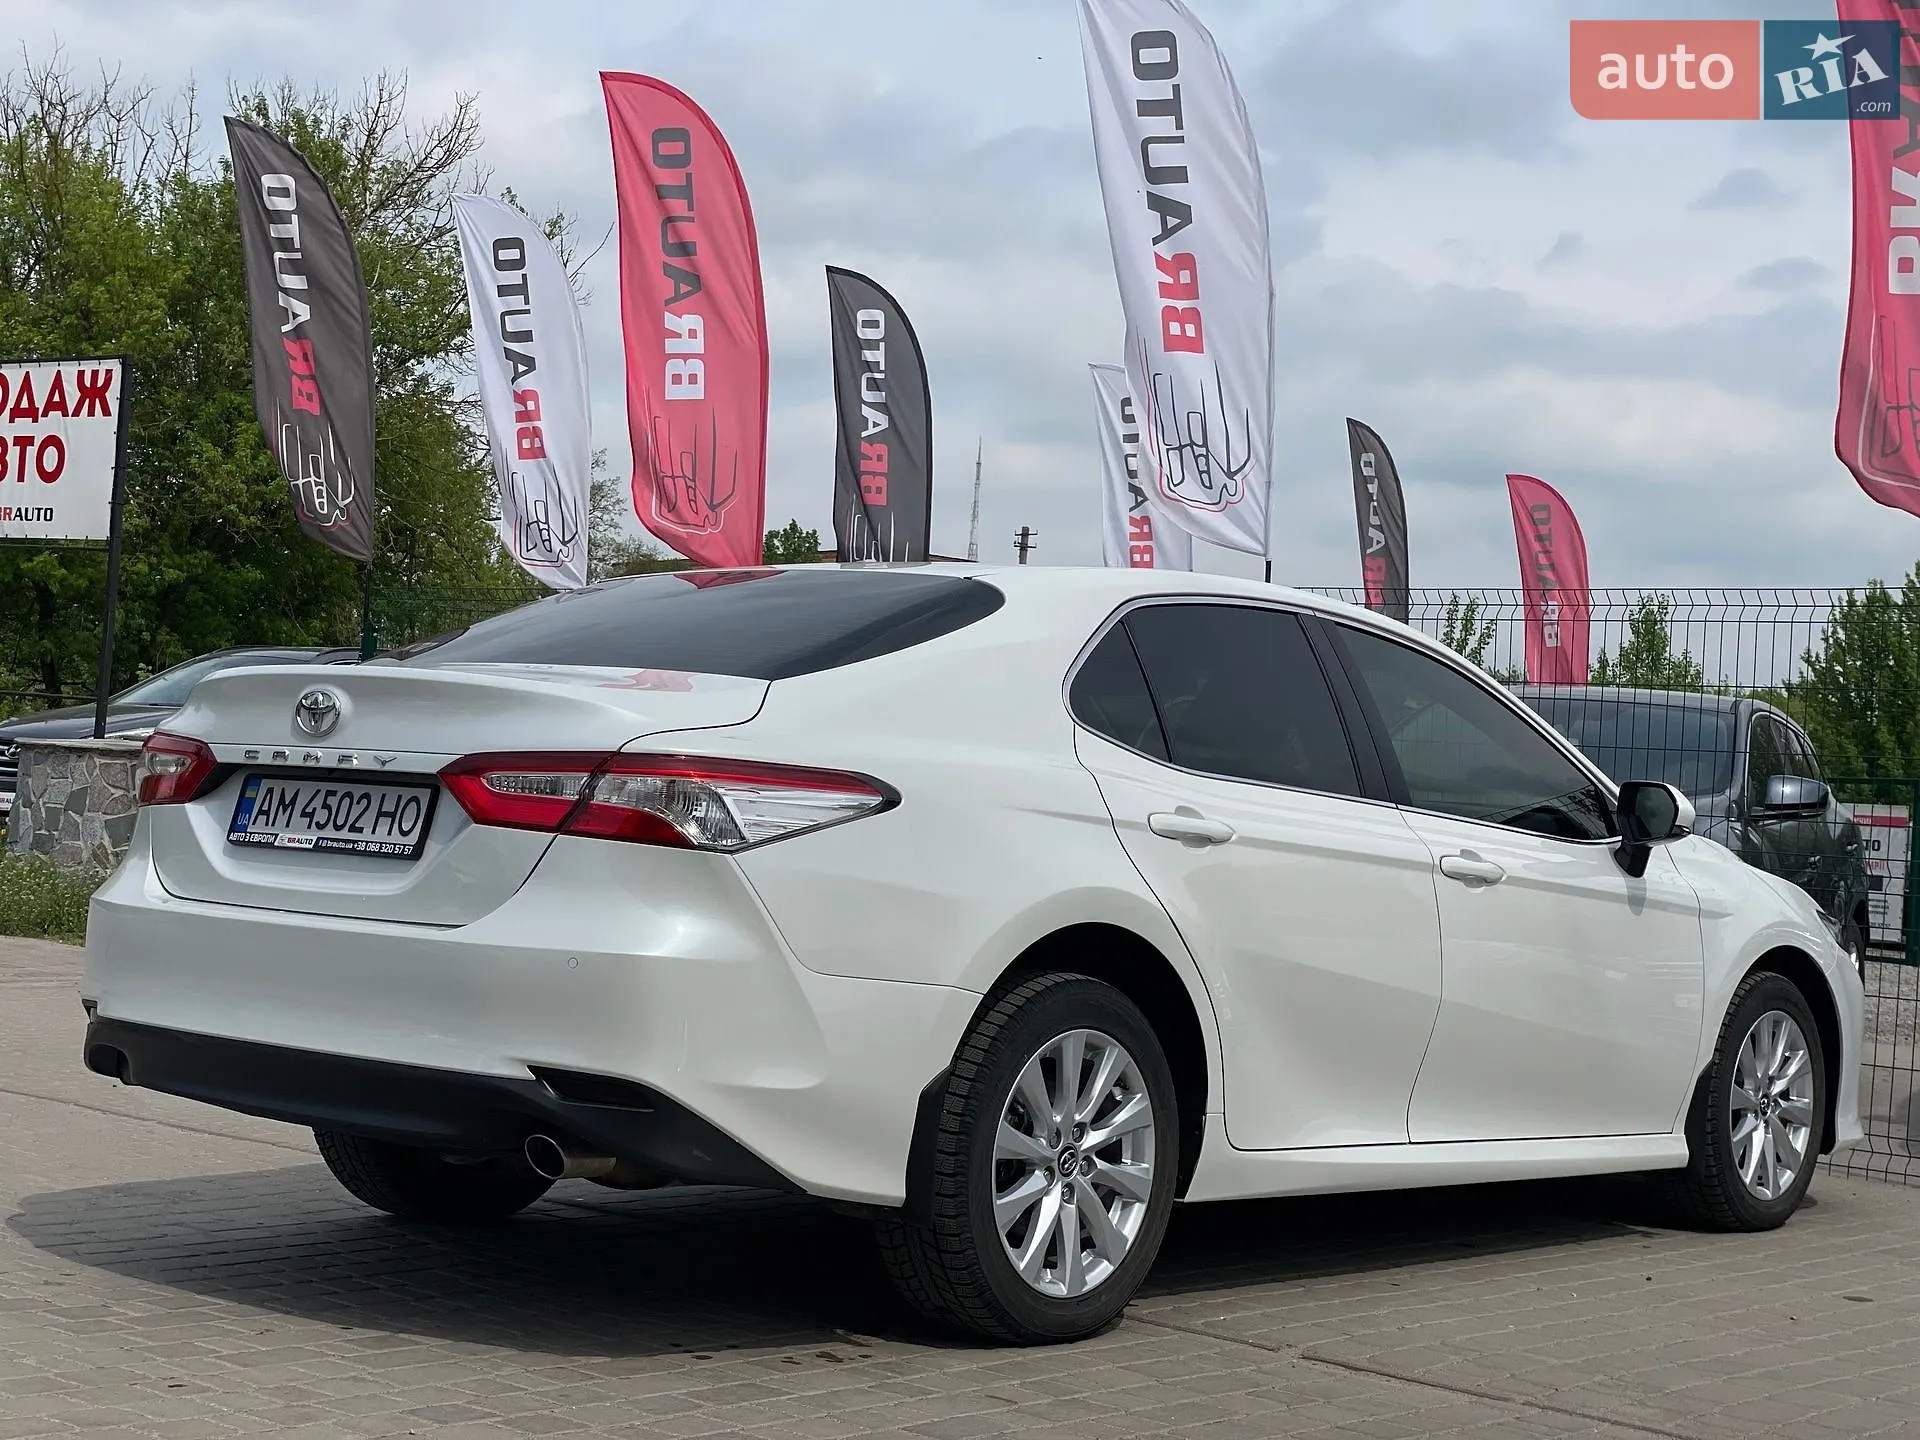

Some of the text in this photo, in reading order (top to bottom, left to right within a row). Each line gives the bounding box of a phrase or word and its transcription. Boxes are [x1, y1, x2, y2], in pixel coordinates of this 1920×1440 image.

[244, 749, 398, 768] CAMRY
[237, 812, 249, 825] UA
[251, 786, 421, 837] AM 4502 HO
[353, 841, 367, 851] +38
[380, 843, 395, 854] 320
[394, 844, 404, 855] 57
[403, 845, 414, 855] 57
